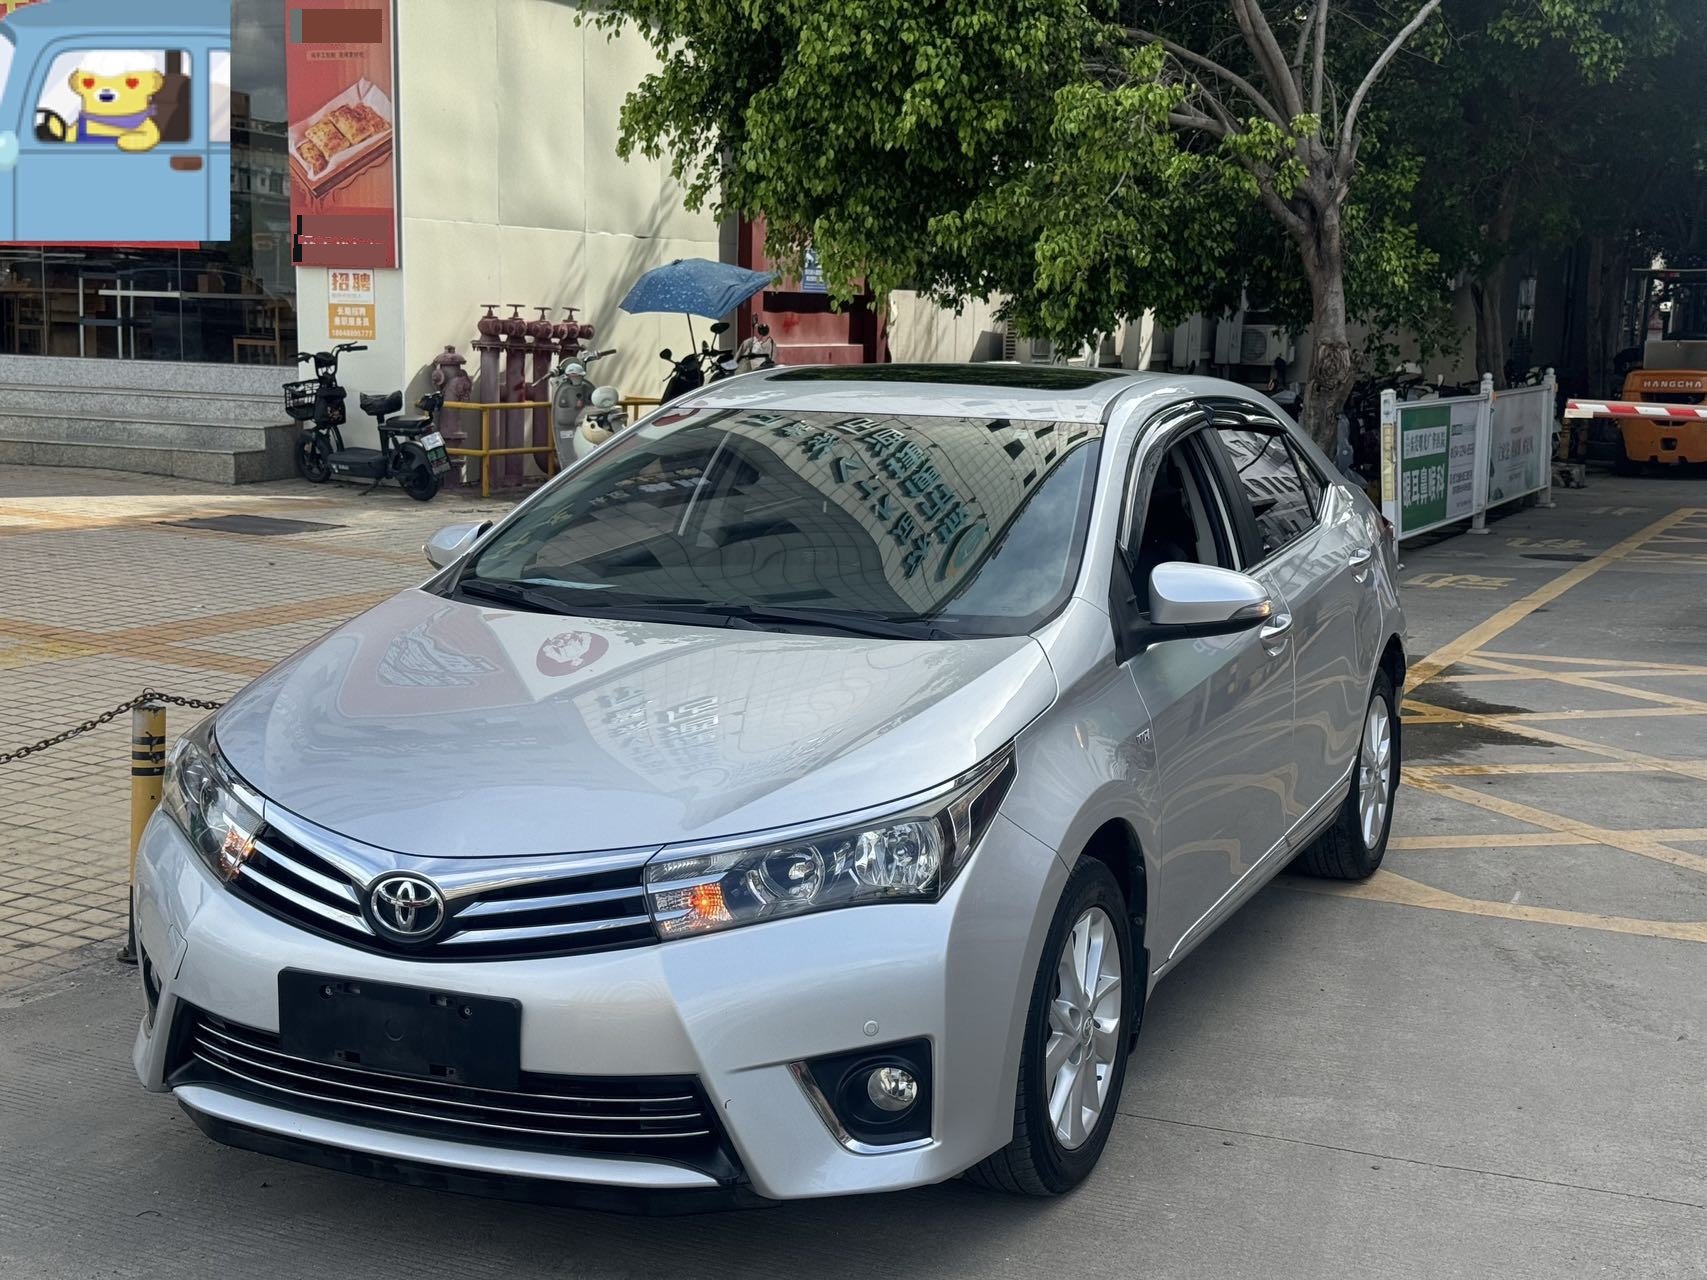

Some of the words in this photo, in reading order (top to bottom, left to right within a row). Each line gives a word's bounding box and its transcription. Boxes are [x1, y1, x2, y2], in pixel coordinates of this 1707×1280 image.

[331, 272, 370, 291] 招聘
[1643, 380, 1702, 388] HANGCHA
[1402, 464, 1446, 508] 眼耳鼻喉科
